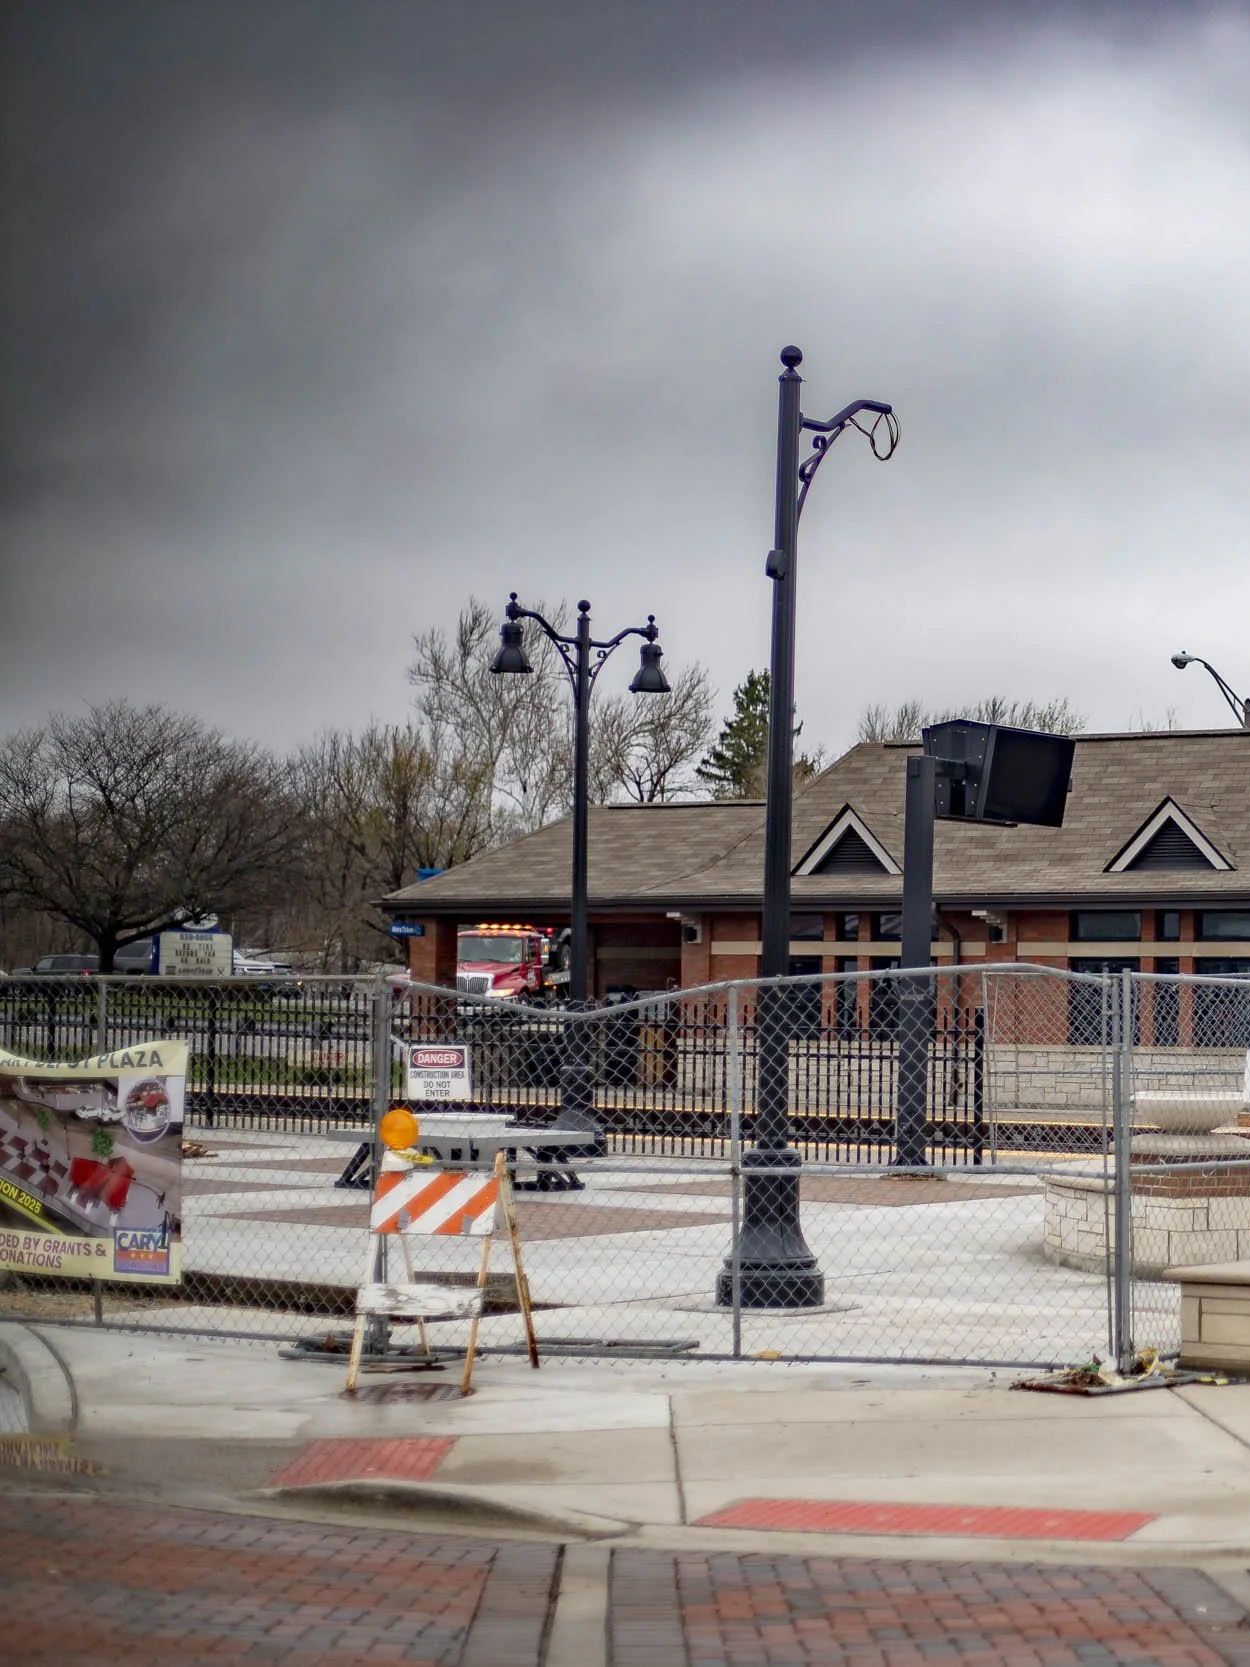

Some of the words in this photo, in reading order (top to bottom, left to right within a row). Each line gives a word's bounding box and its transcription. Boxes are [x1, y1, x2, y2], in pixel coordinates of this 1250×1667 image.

[97, 1051, 163, 1068] PLAZA
[417, 1053, 457, 1064] DANGER
[410, 1070, 450, 1079] CONSTRUCTION
[451, 1070, 465, 1079] AREA
[423, 1080, 434, 1089] DO
[436, 1080, 451, 1089] NOT
[425, 1089, 450, 1097] ENTER
[18, 1192, 42, 1214] 2025
[23, 1237, 40, 1251] BY
[43, 1239, 92, 1257] GRANTS
[95, 1243, 107, 1257] &
[117, 1232, 162, 1252] CARY
